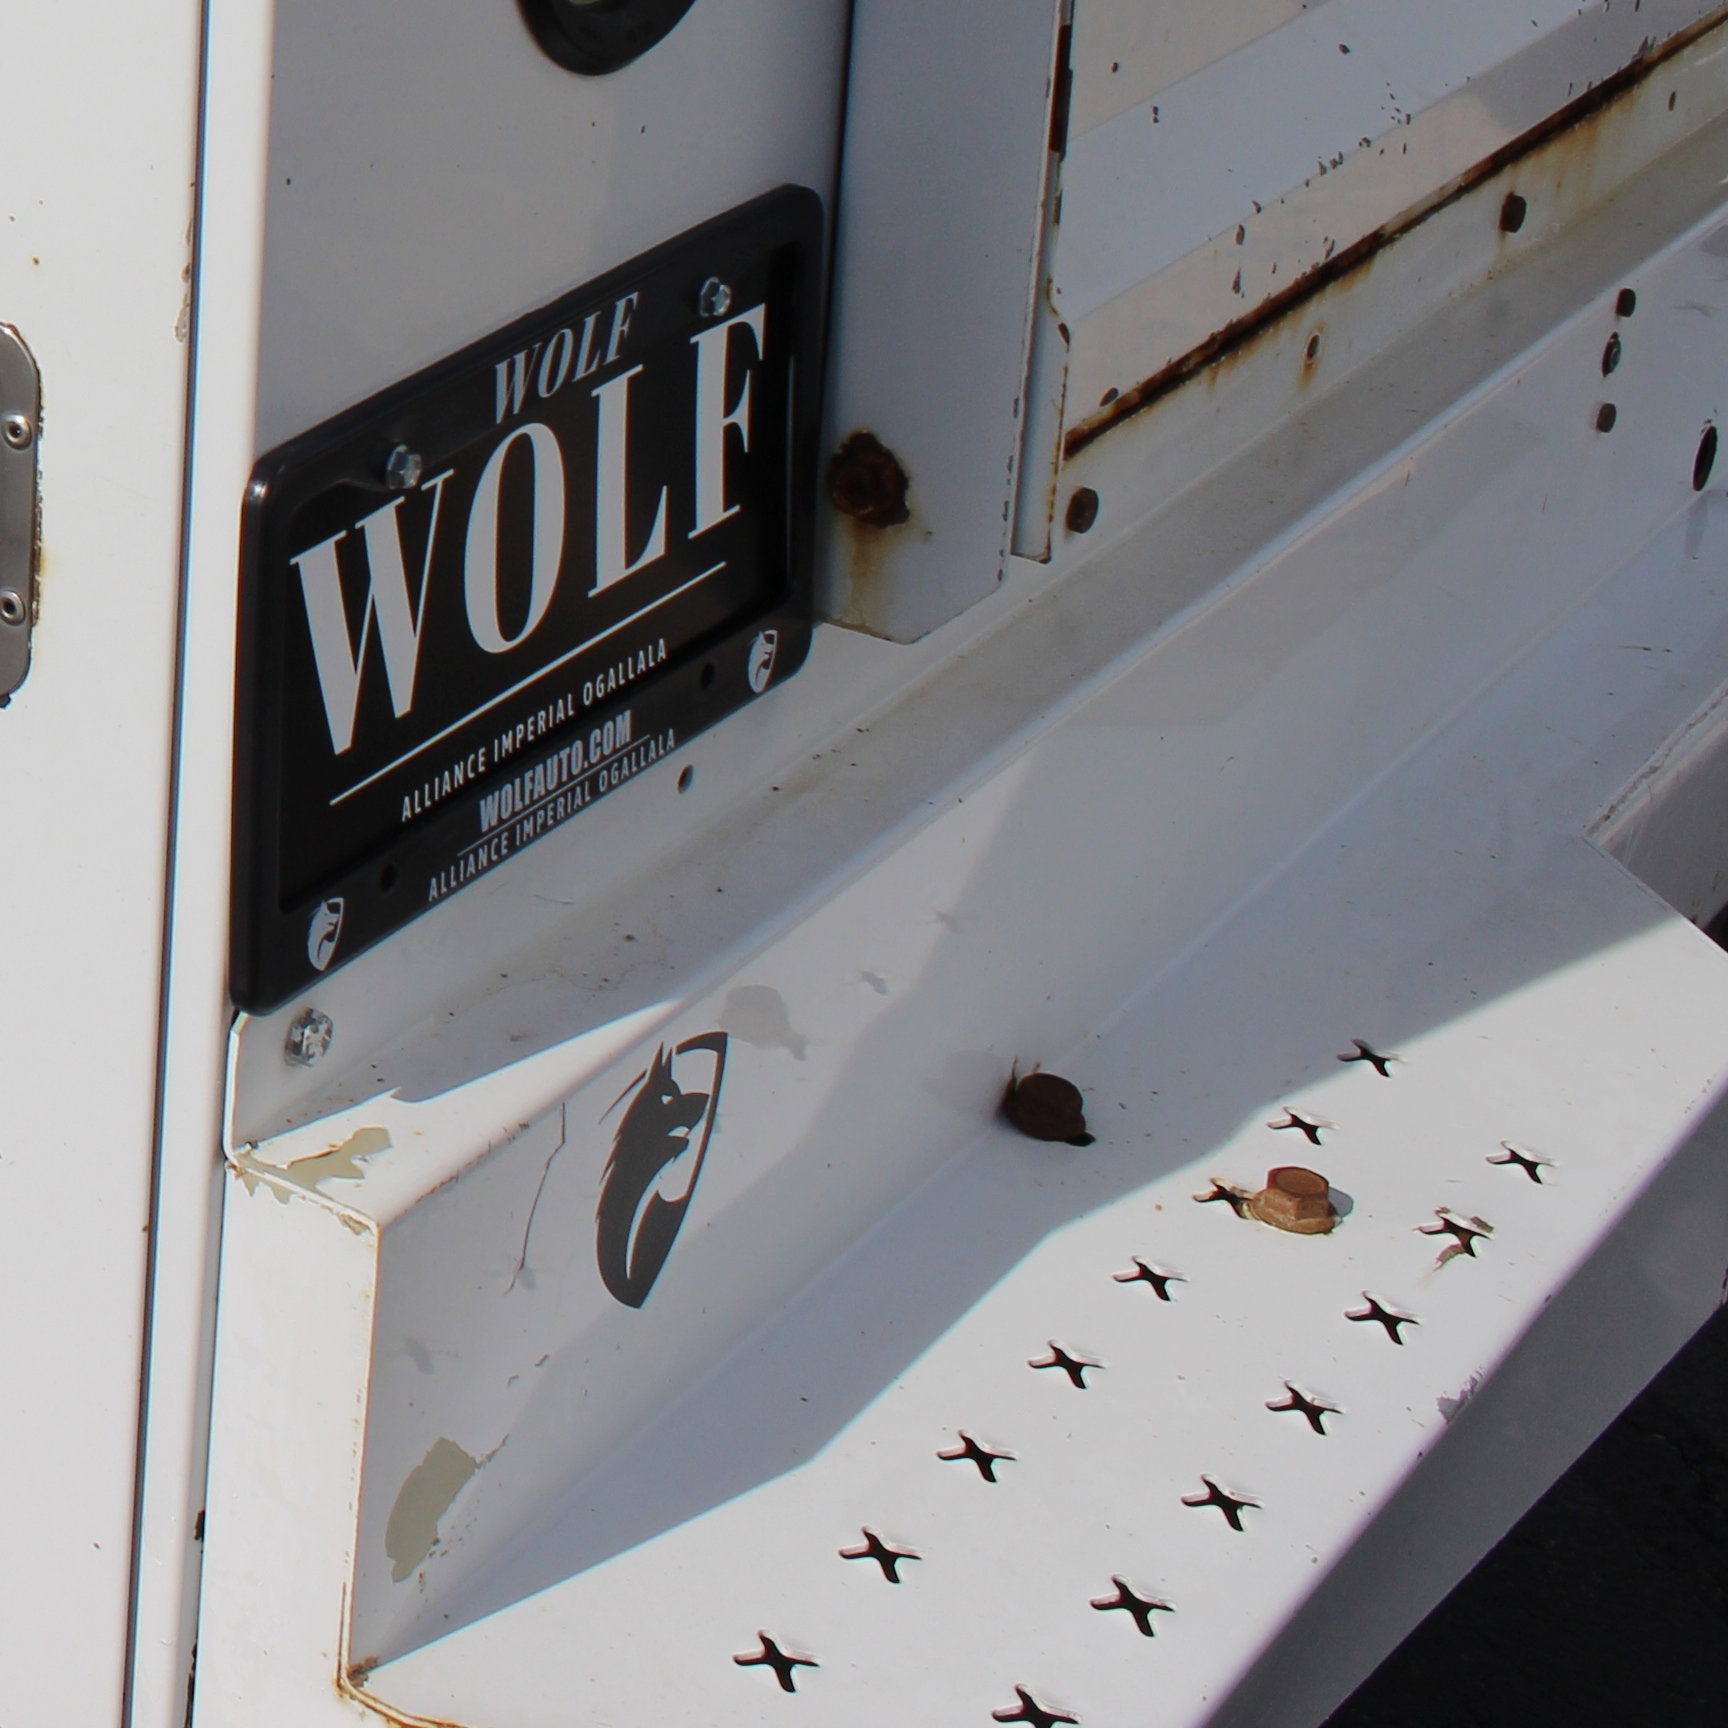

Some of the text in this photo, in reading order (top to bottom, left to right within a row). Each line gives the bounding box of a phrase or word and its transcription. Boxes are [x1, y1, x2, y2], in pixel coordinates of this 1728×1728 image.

[495, 290, 640, 425] WOLF
[289, 302, 767, 757] WOLF
[402, 637, 667, 822] ALLIANCE IMPERIAL OGALLALA
[427, 728, 676, 902] ALLIANCE IMPERIAL OGALLALA
[479, 709, 632, 833] WOLFAUTO.COM
